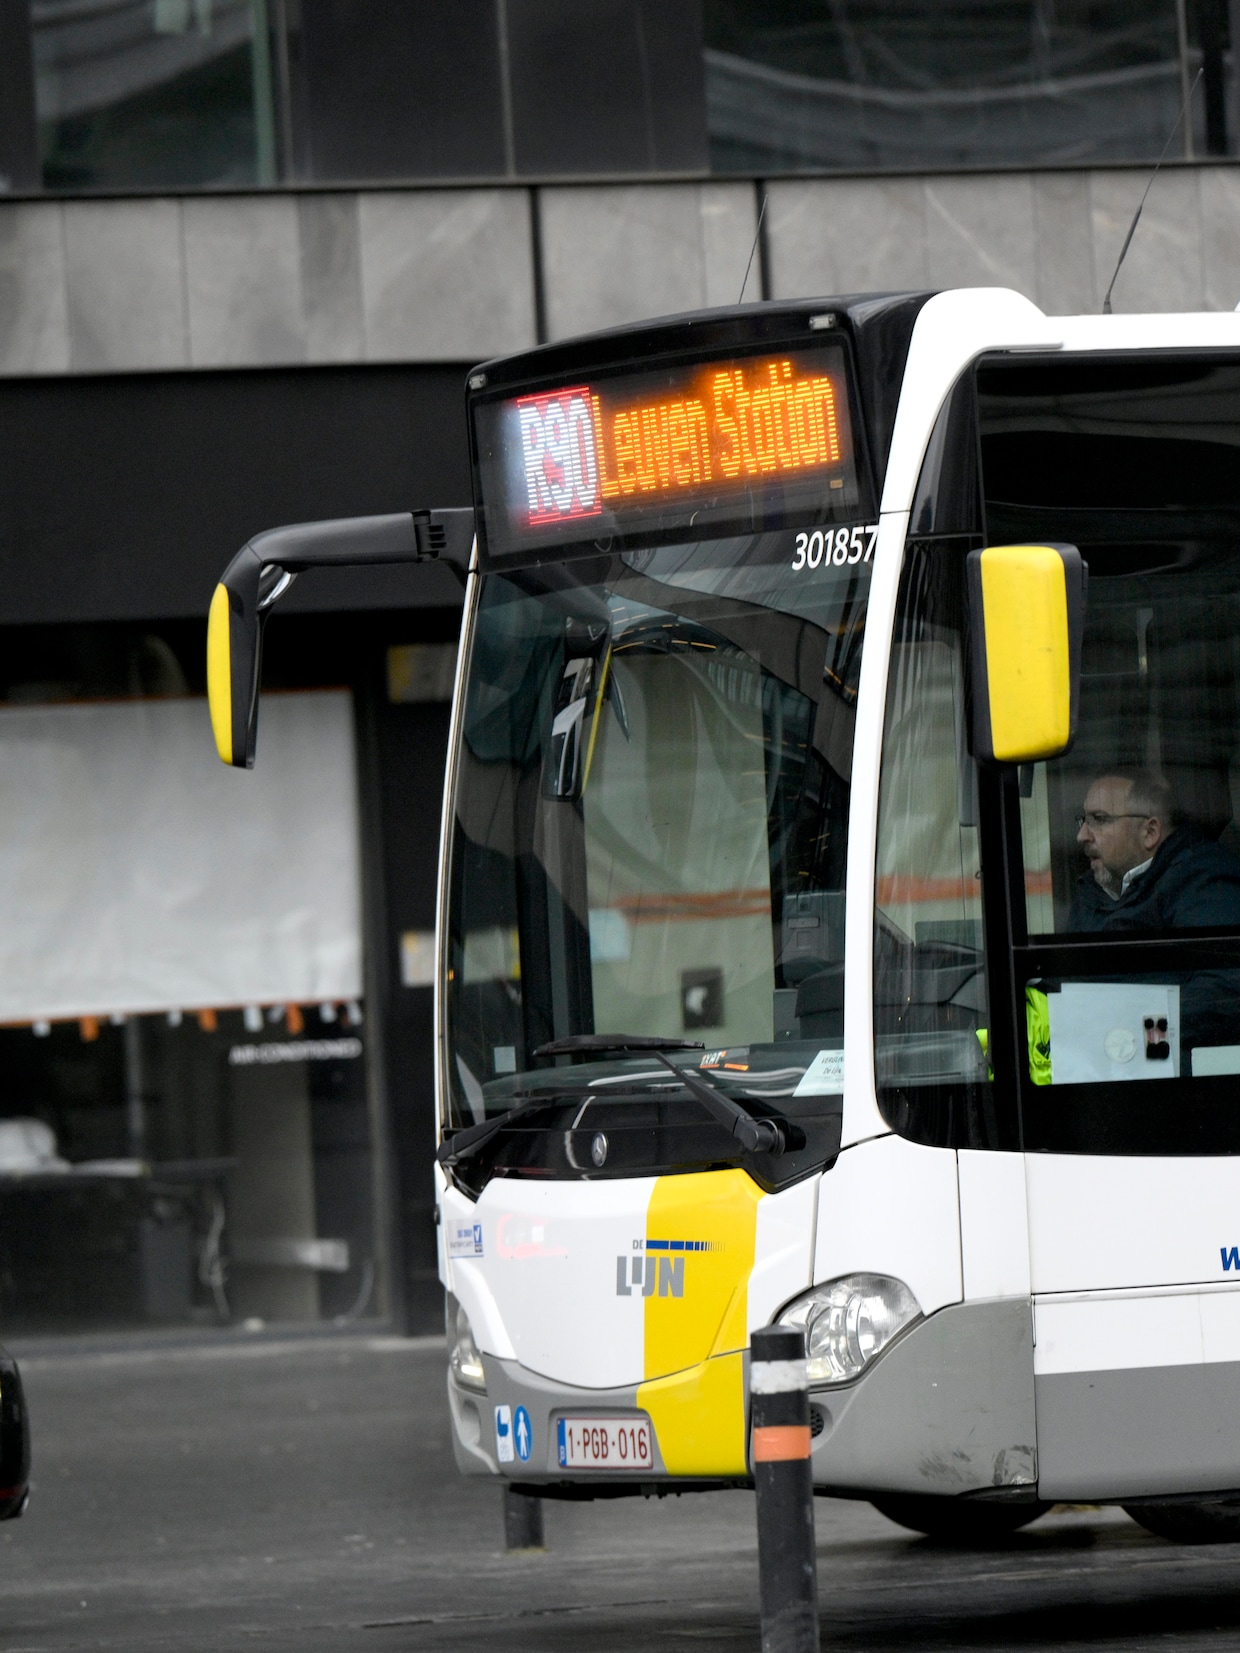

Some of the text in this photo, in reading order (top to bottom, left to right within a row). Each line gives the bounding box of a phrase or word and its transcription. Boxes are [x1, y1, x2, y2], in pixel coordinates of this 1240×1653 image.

[591, 361, 839, 498] Leuven Station
[519, 397, 598, 510] R90
[791, 525, 879, 571] 301857
[632, 1239, 644, 1250] DE
[616, 1255, 685, 1298] LIJN
